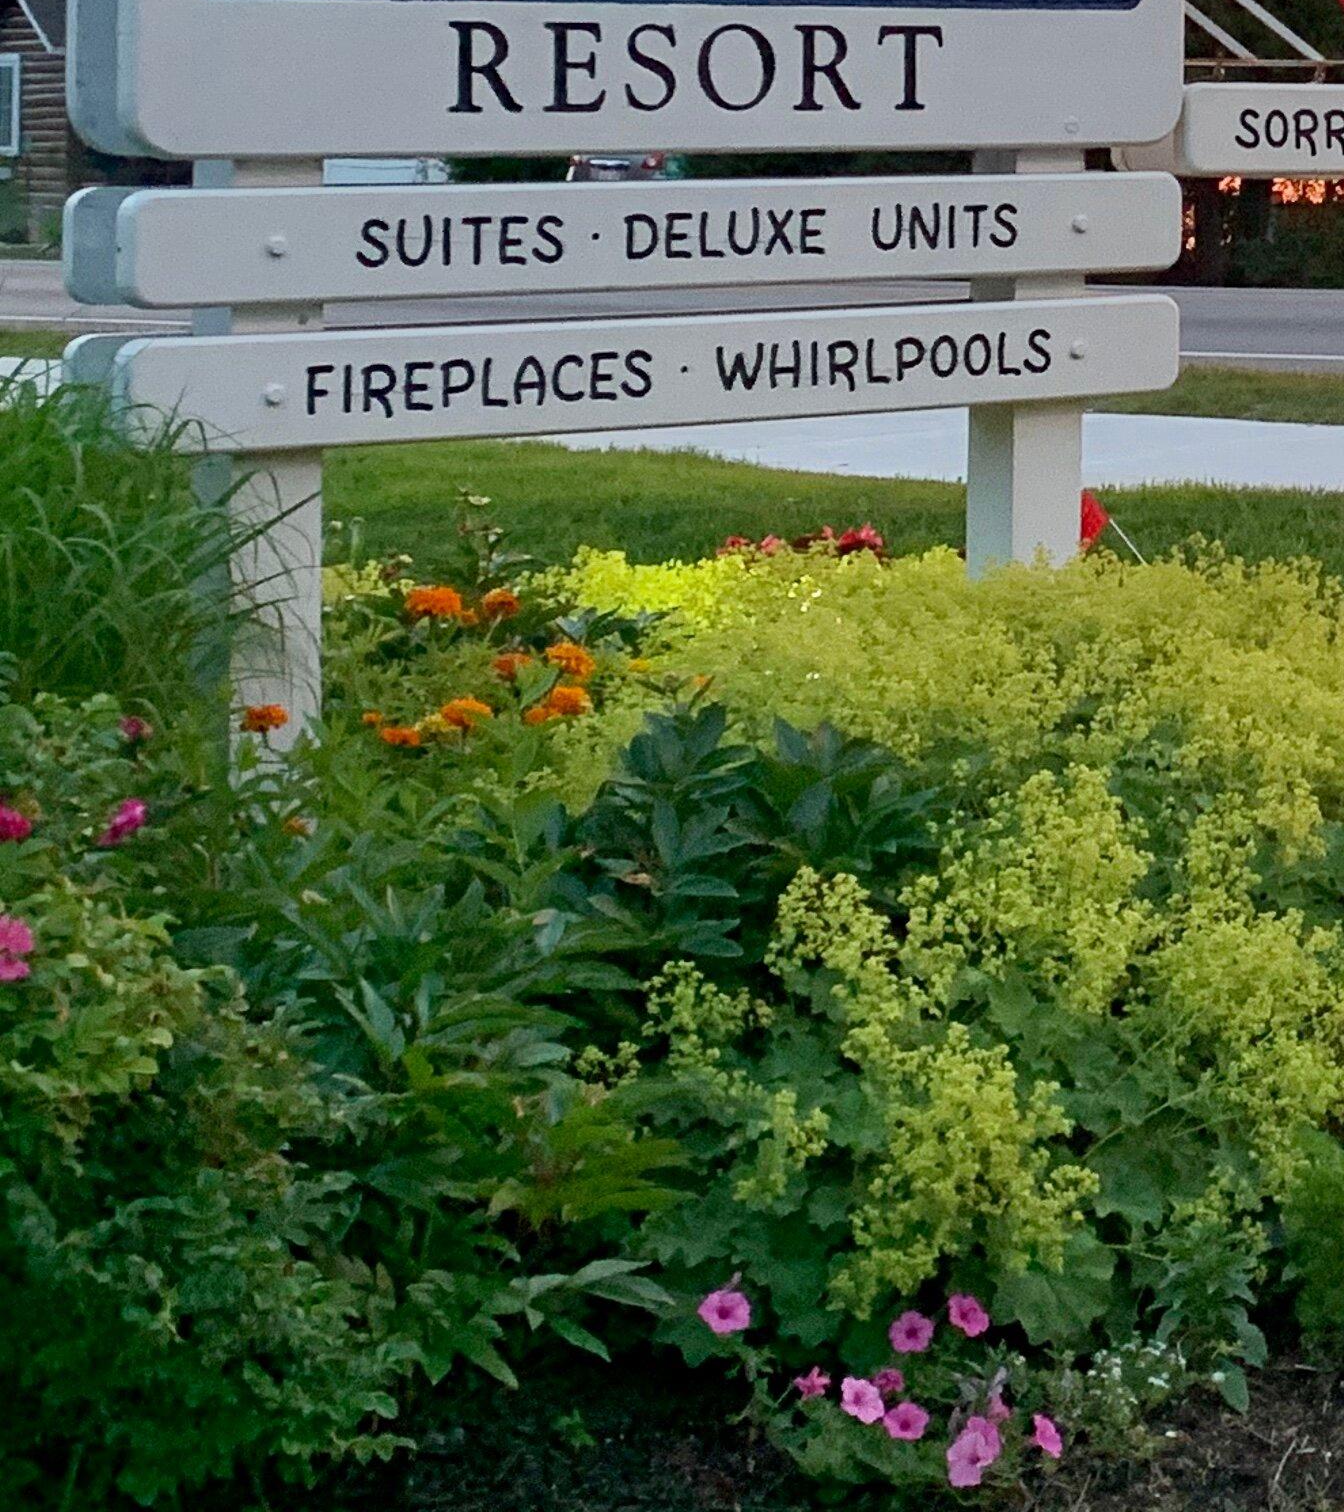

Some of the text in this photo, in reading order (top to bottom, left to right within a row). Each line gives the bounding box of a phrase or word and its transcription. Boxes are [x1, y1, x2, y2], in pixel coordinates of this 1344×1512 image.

[447, 19, 944, 114] RESORT
[354, 201, 1020, 268] SUITES DELUXE UNITS
[304, 327, 1053, 419] FIREPLACES WHIRLPOOLS
